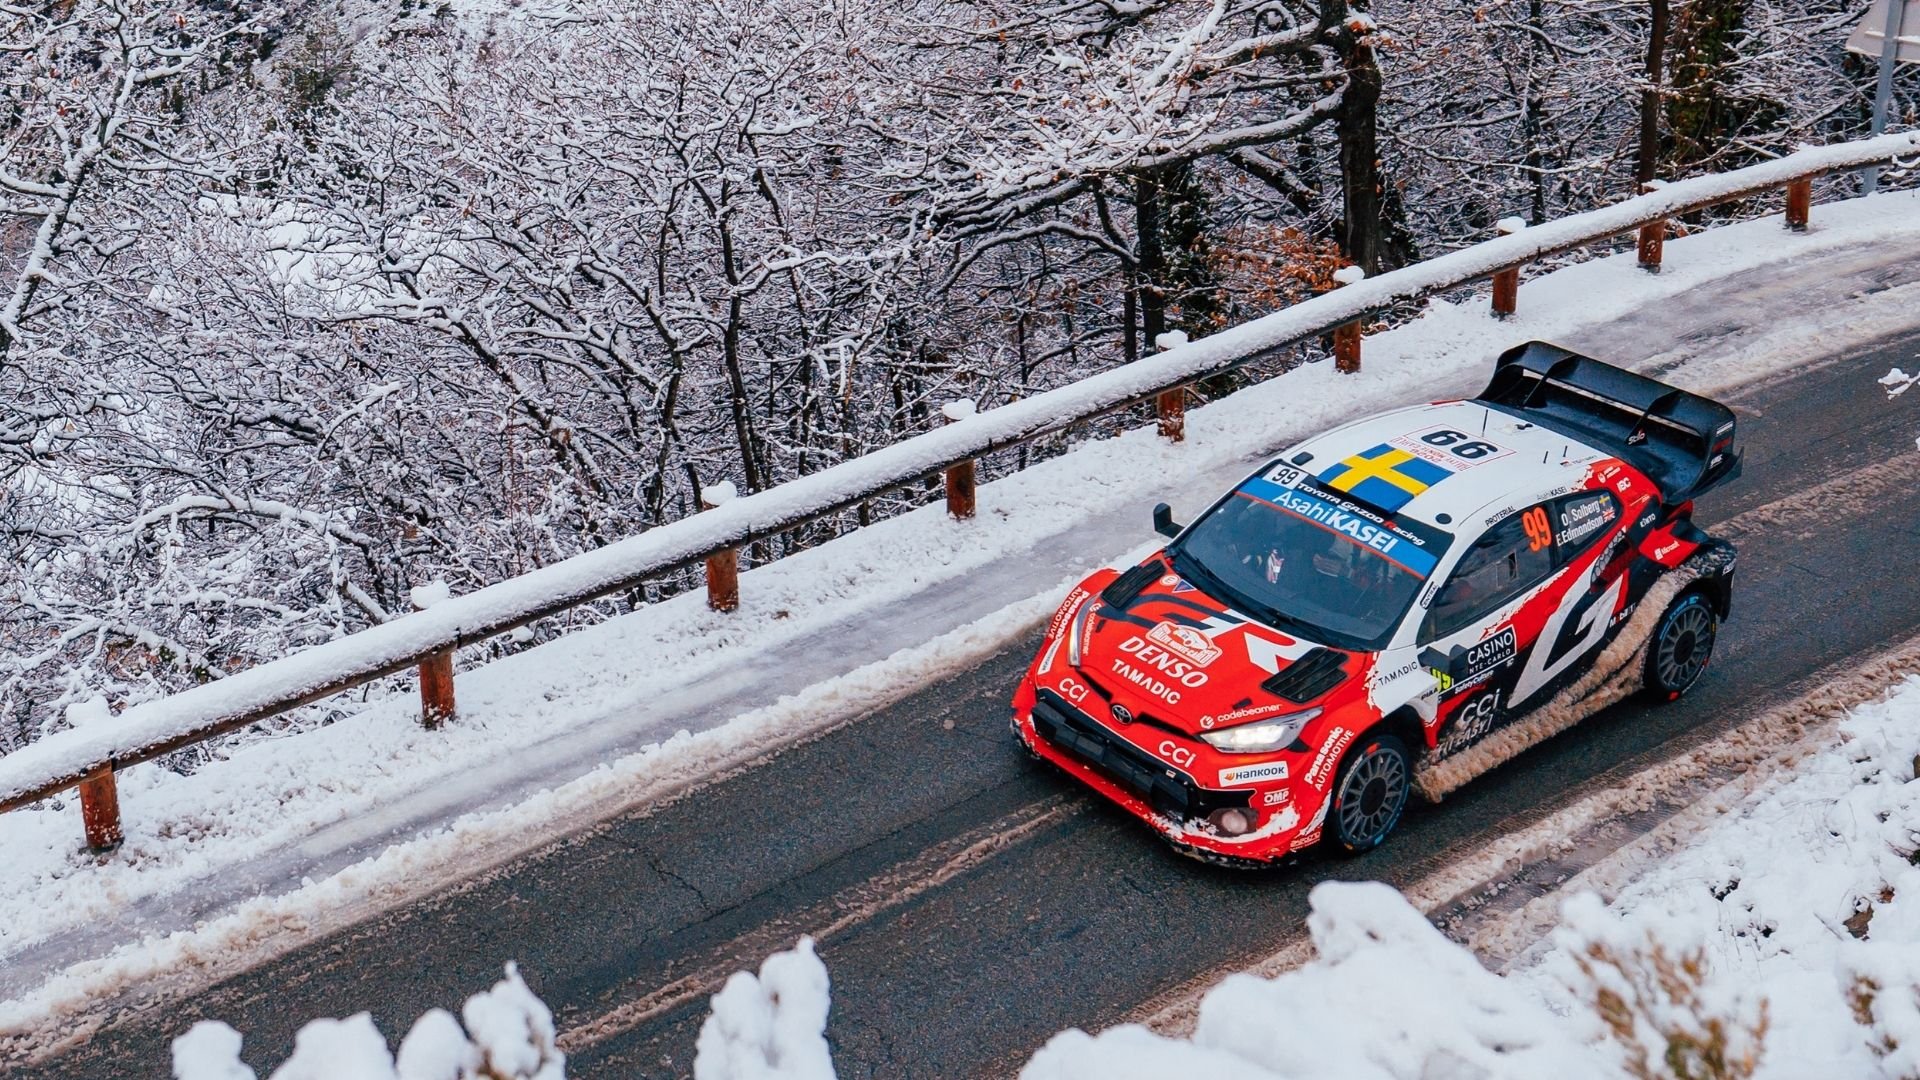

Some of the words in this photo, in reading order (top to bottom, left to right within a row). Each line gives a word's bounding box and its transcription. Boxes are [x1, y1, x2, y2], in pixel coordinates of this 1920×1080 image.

[1271, 468, 1299, 485] 99
[1297, 483, 1341, 504] TOYOTA
[1338, 501, 1385, 524] GAZOO
[1383, 519, 1426, 547] Racing
[1484, 505, 1517, 528] PROTERIAL
[1571, 499, 1601, 521] Solberg
[1521, 506, 1553, 552] 99
[1055, 590, 1091, 640] Panasonic
[1118, 636, 1209, 688] DENSO
[1467, 632, 1513, 665] CASINO
[1468, 648, 1511, 675] NTE-CARLO
[1111, 659, 1181, 705] TAMADIC
[1377, 661, 1419, 687] TAMADIC
[1217, 703, 1282, 723] codebeamer
[1304, 726, 1344, 785] Panasonic
[1314, 729, 1355, 792] AUTOMOTIVE
[1264, 790, 1290, 804] OMP
